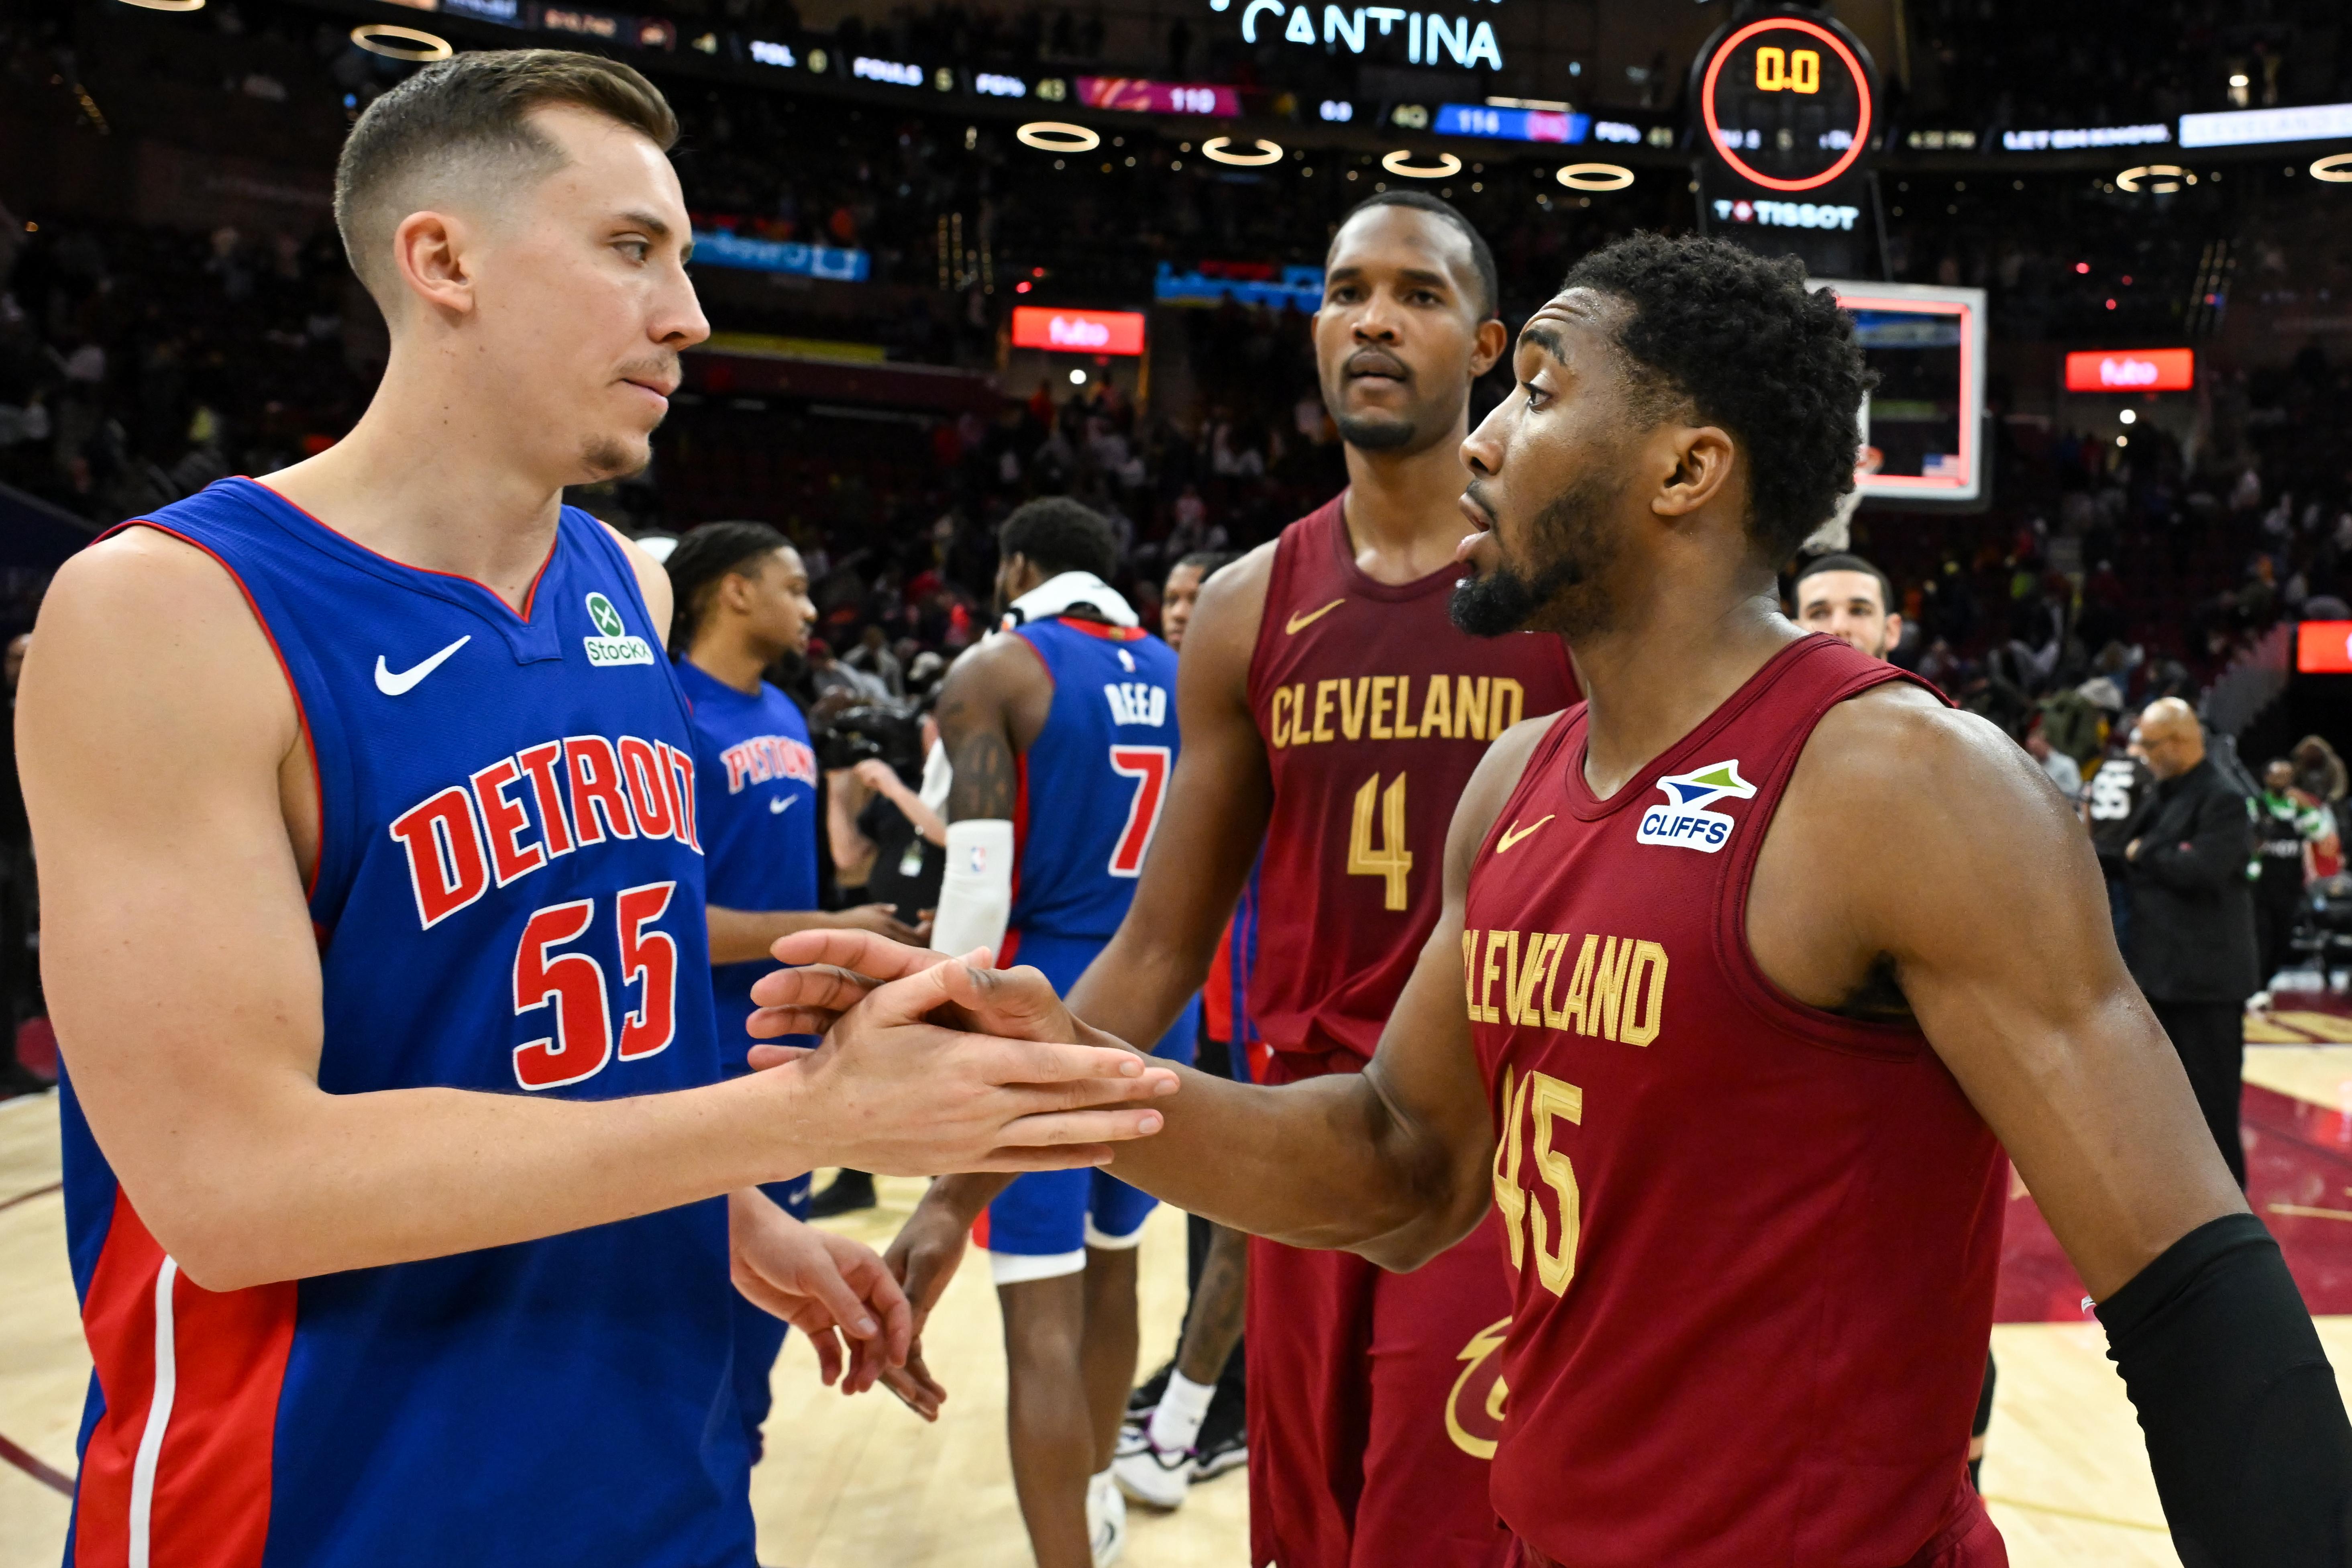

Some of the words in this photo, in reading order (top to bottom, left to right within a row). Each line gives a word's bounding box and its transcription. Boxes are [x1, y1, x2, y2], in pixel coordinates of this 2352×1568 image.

[1756, 47, 1820, 94] 0.0
[1753, 200, 1860, 231] TISSOT
[1104, 682, 1167, 728] REED
[1272, 674, 1524, 749] CLEVELAND
[389, 735, 704, 930] DETROIT
[1108, 745, 1171, 878] 7
[1347, 771, 1413, 911] 4
[1643, 814, 1727, 844] CLIFFS
[512, 881, 677, 1091] 55
[1492, 1062, 1583, 1298] 45
